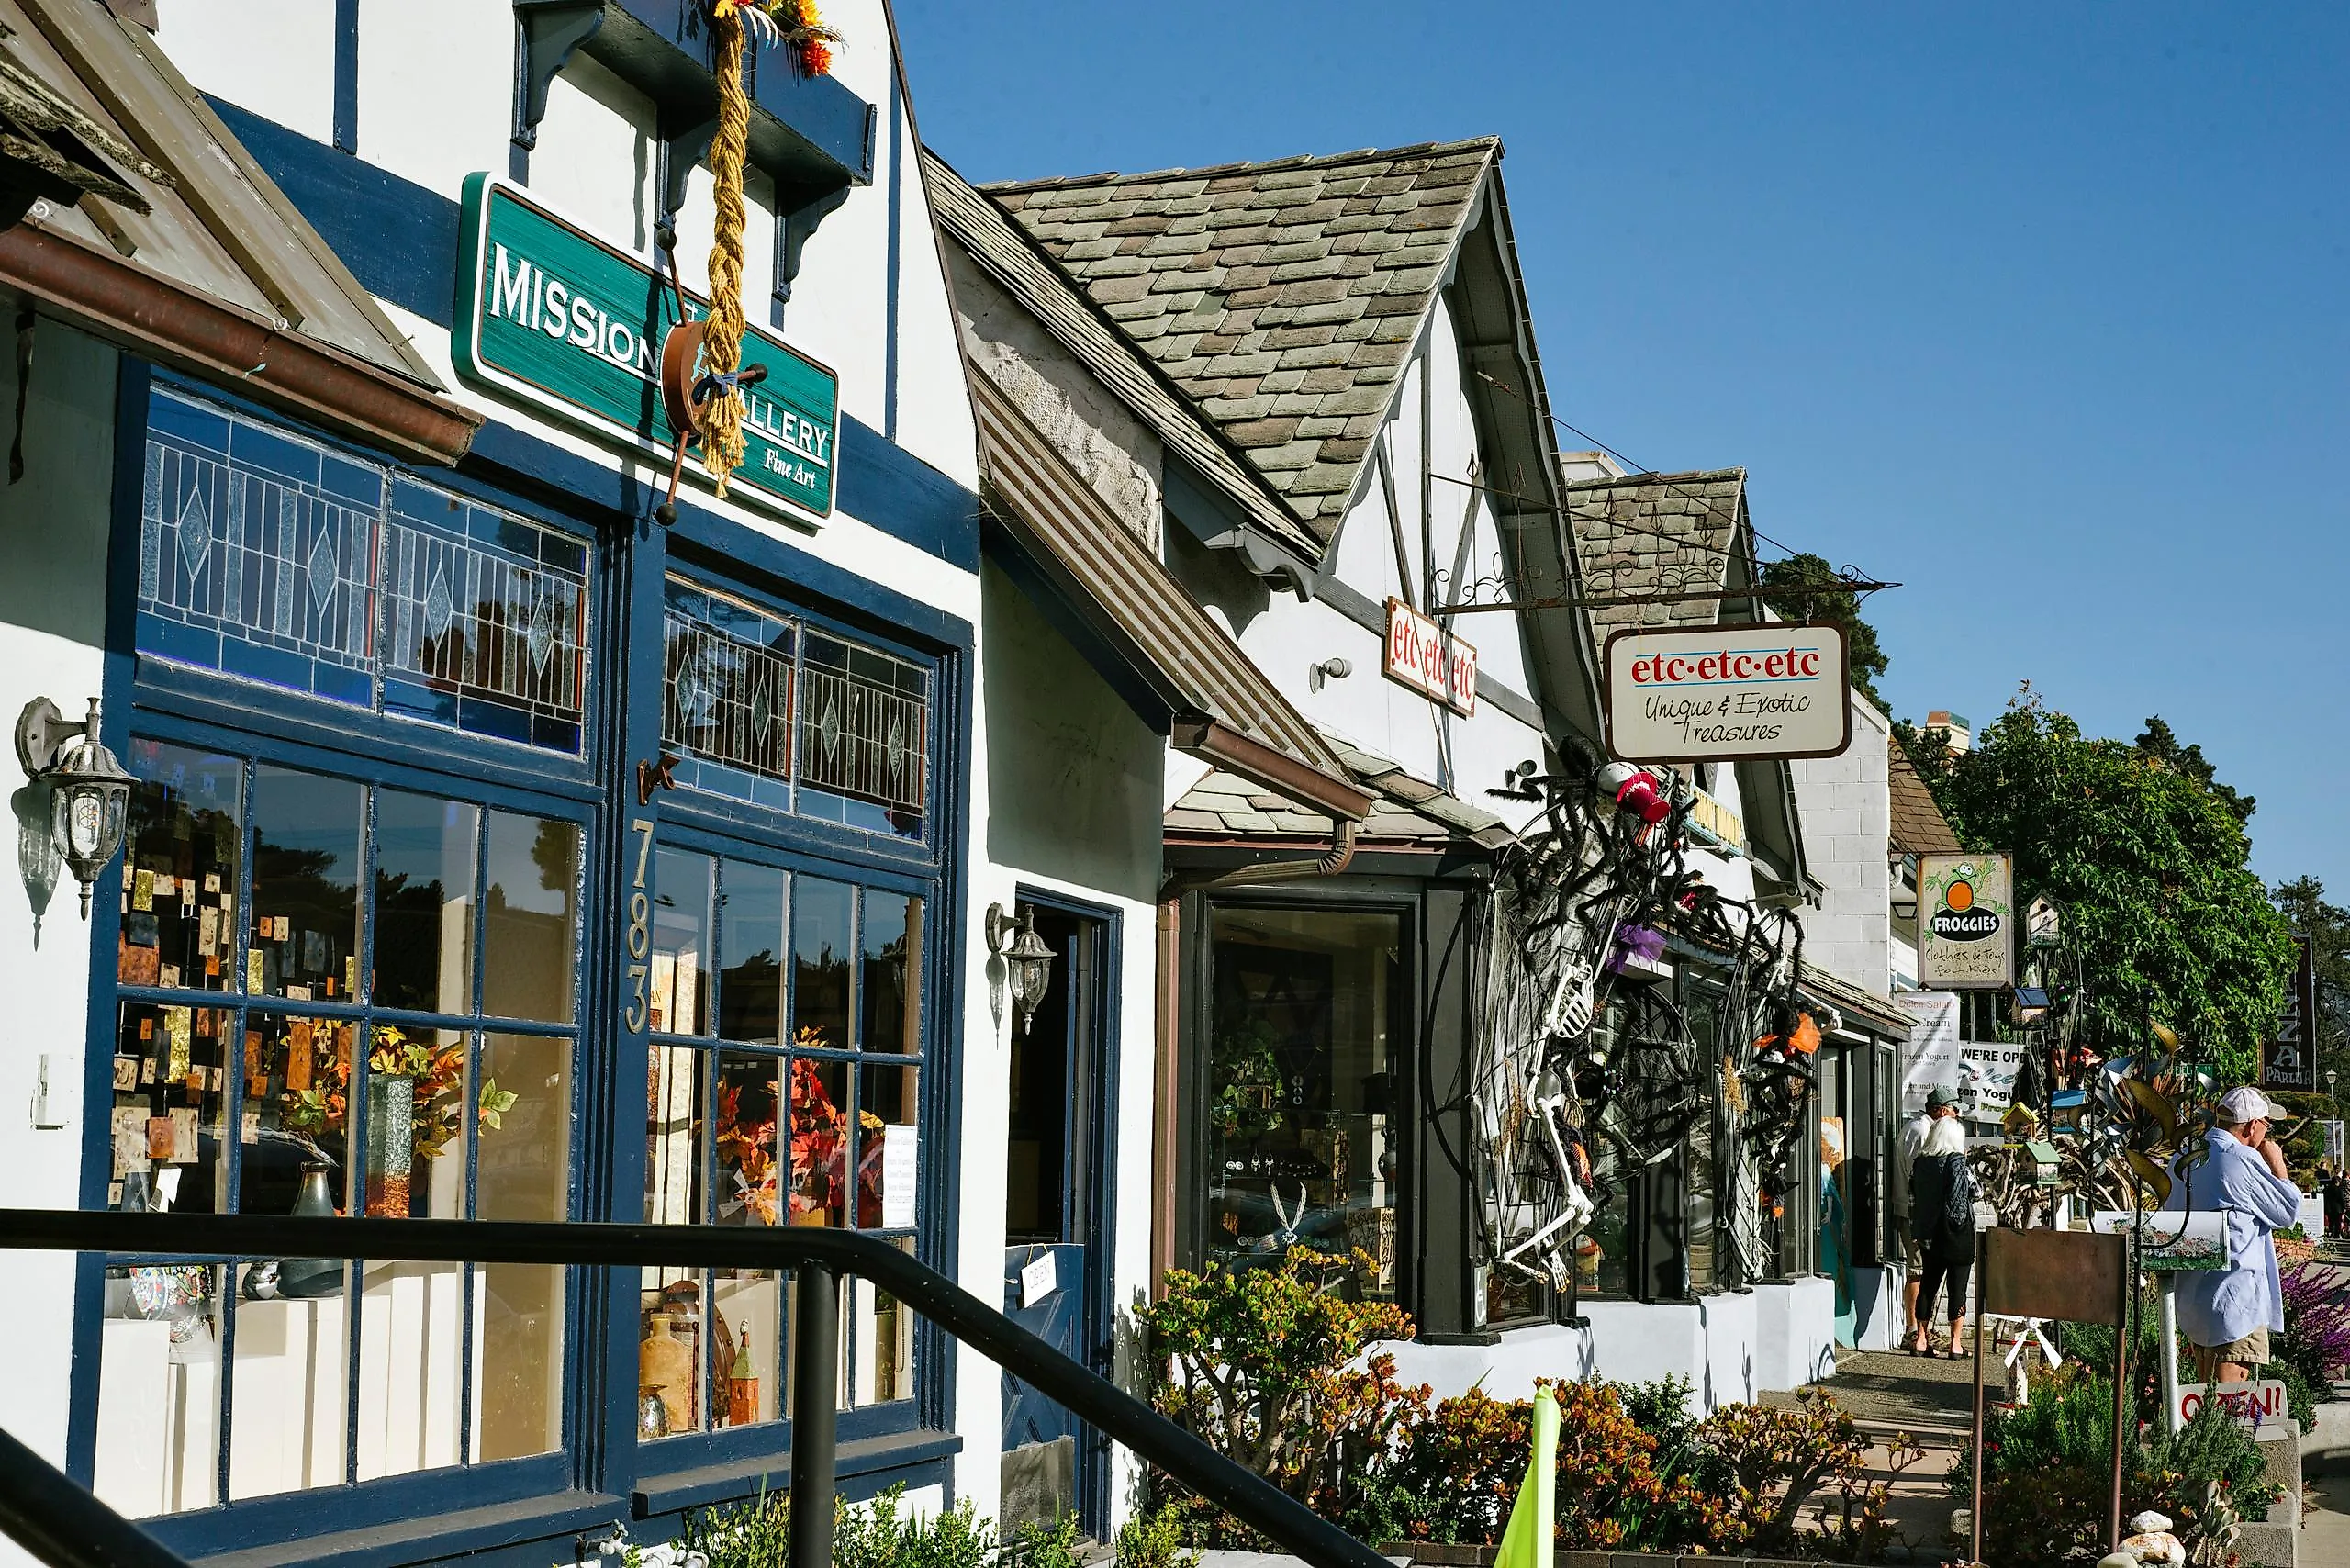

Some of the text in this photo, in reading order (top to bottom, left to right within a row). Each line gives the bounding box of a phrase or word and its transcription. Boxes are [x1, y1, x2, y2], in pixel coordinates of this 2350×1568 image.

[490, 242, 659, 376] MISSION
[738, 387, 828, 458] ALLERY
[764, 448, 816, 489] Fine Art
[1394, 616, 1472, 700] etc etc etc
[1645, 692, 1811, 722] Unique & Exotic
[1674, 719, 1783, 745] Treasures
[625, 819, 654, 1035] 783
[1934, 916, 1997, 932] FROGGIES
[1926, 945, 1968, 961] Clothes
[1983, 948, 2005, 968] Toys
[1903, 1052, 1949, 1062] rozen Yogurt
[1961, 1049, 2025, 1063] WE'RE OPE
[1957, 1088, 1977, 1097] zen
